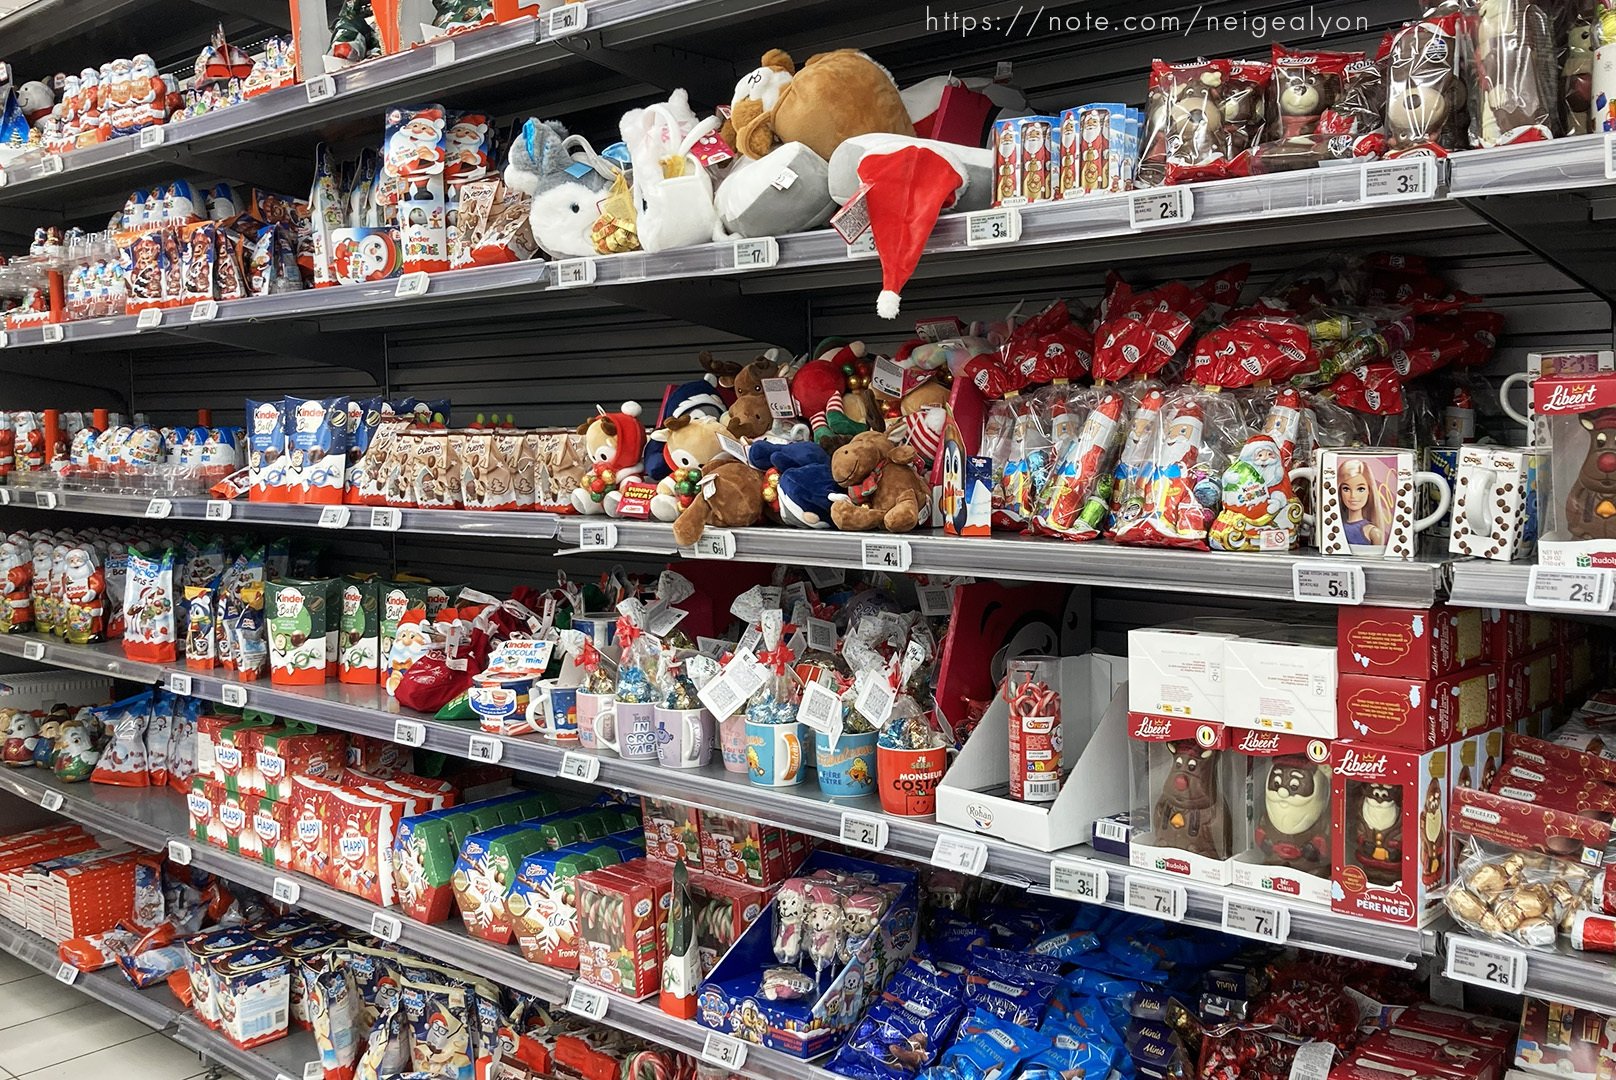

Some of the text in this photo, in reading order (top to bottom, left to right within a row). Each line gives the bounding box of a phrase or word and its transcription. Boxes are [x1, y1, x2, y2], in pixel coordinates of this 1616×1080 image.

[1542, 384, 1598, 411] Libeert
[255, 409, 279, 419] Kinder
[296, 407, 324, 417] Kinder
[628, 486, 655, 494] FUNNY
[276, 591, 305, 604] Kinder
[386, 592, 408, 606] Kinder
[503, 641, 533, 650] Kinder
[634, 721, 649, 733] IN
[1134, 716, 1172, 737] Libeert
[627, 733, 656, 745] CRO
[1238, 729, 1280, 751] Libeert
[1333, 749, 1388, 776] Libeert
[899, 771, 943, 781] MONSIEUR
[892, 778, 938, 792] COSTA
[968, 805, 993, 822] Rohan
[1465, 807, 1497, 821] RIEGELEIN
[1166, 861, 1189, 873] Rudolph
[1276, 884, 1294, 893] Claus
[1382, 904, 1410, 918] NOËL
[558, 949, 578, 958] Tronky
[1139, 999, 1160, 1011] Minis
[1139, 1027, 1162, 1040] Minis
[1143, 1043, 1166, 1057] Minis
